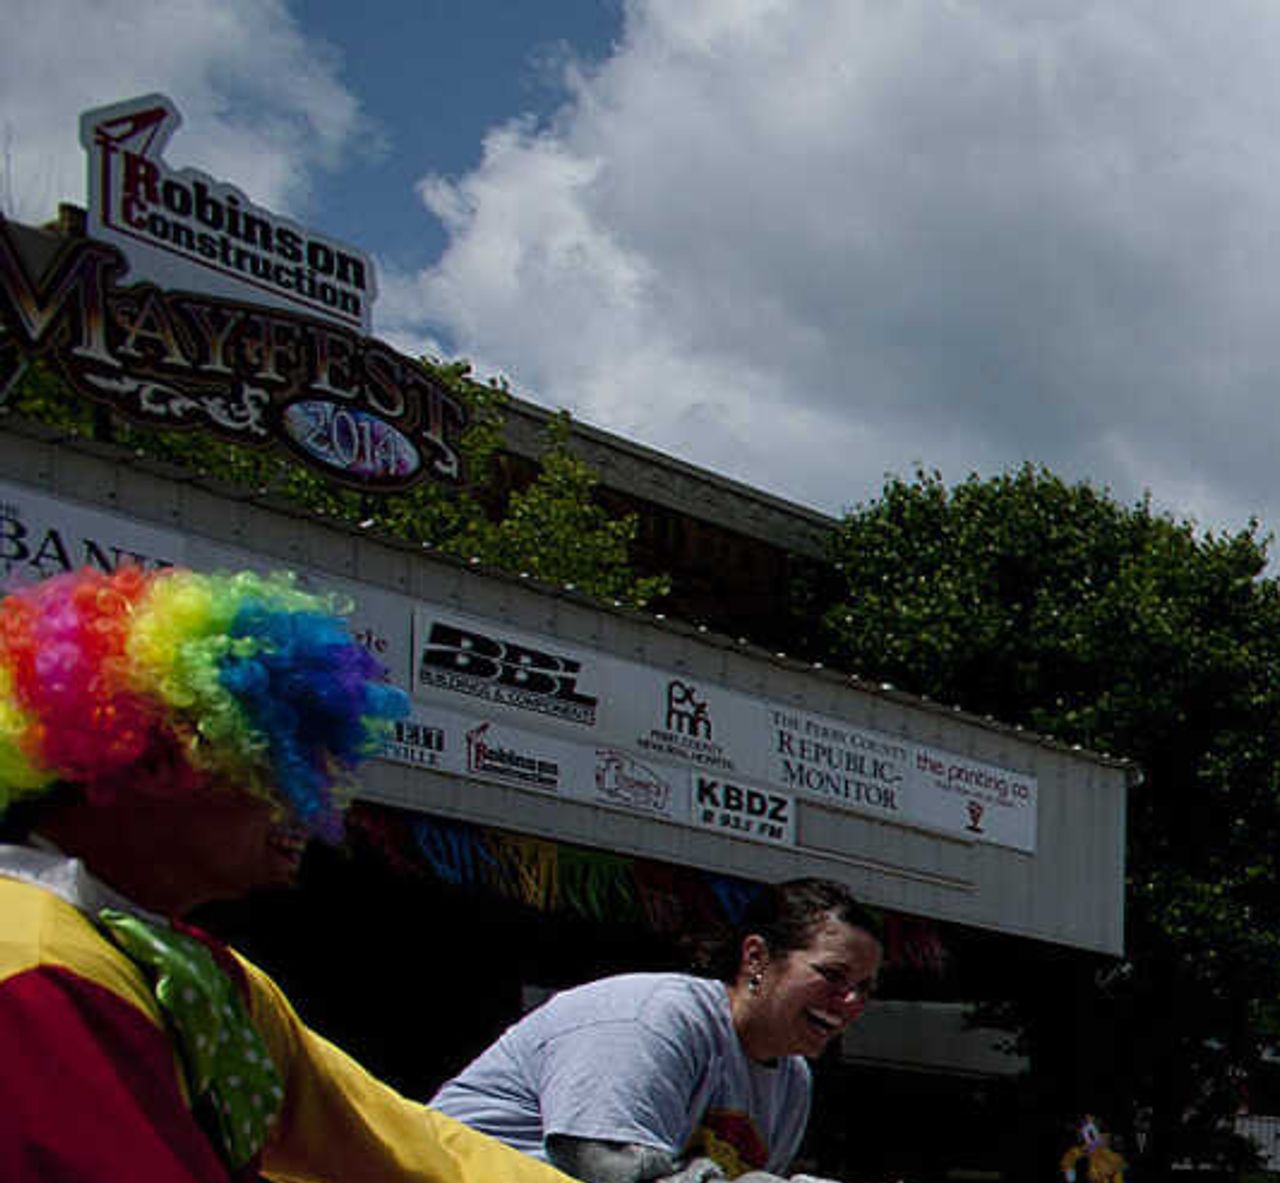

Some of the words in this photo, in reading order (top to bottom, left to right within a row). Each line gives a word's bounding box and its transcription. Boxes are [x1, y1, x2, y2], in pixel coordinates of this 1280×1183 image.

[122, 200, 361, 316] Construction
[123, 150, 366, 290] Robinson
[0, 212, 468, 480] MAYFEST
[698, 777, 788, 823] KBDZ
[782, 760, 899, 811] MONITOR
[916, 750, 945, 776] the
